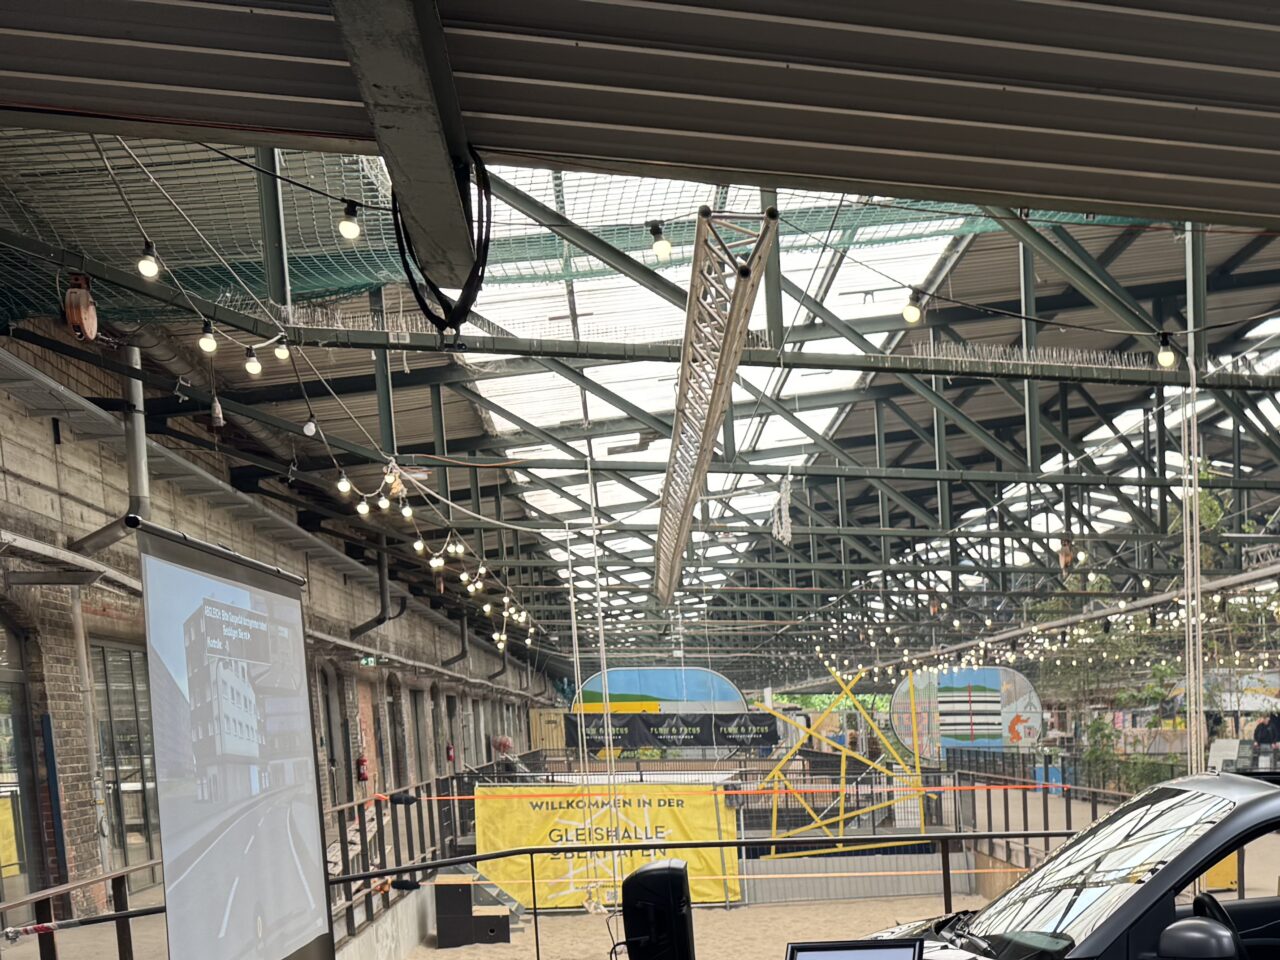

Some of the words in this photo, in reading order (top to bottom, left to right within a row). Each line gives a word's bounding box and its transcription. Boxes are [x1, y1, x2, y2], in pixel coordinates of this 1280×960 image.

[529, 798, 632, 811] WILLKOMMEN
[637, 799, 651, 808] IN
[657, 799, 685, 808] DER
[548, 825, 666, 843] GLEISHALLE
